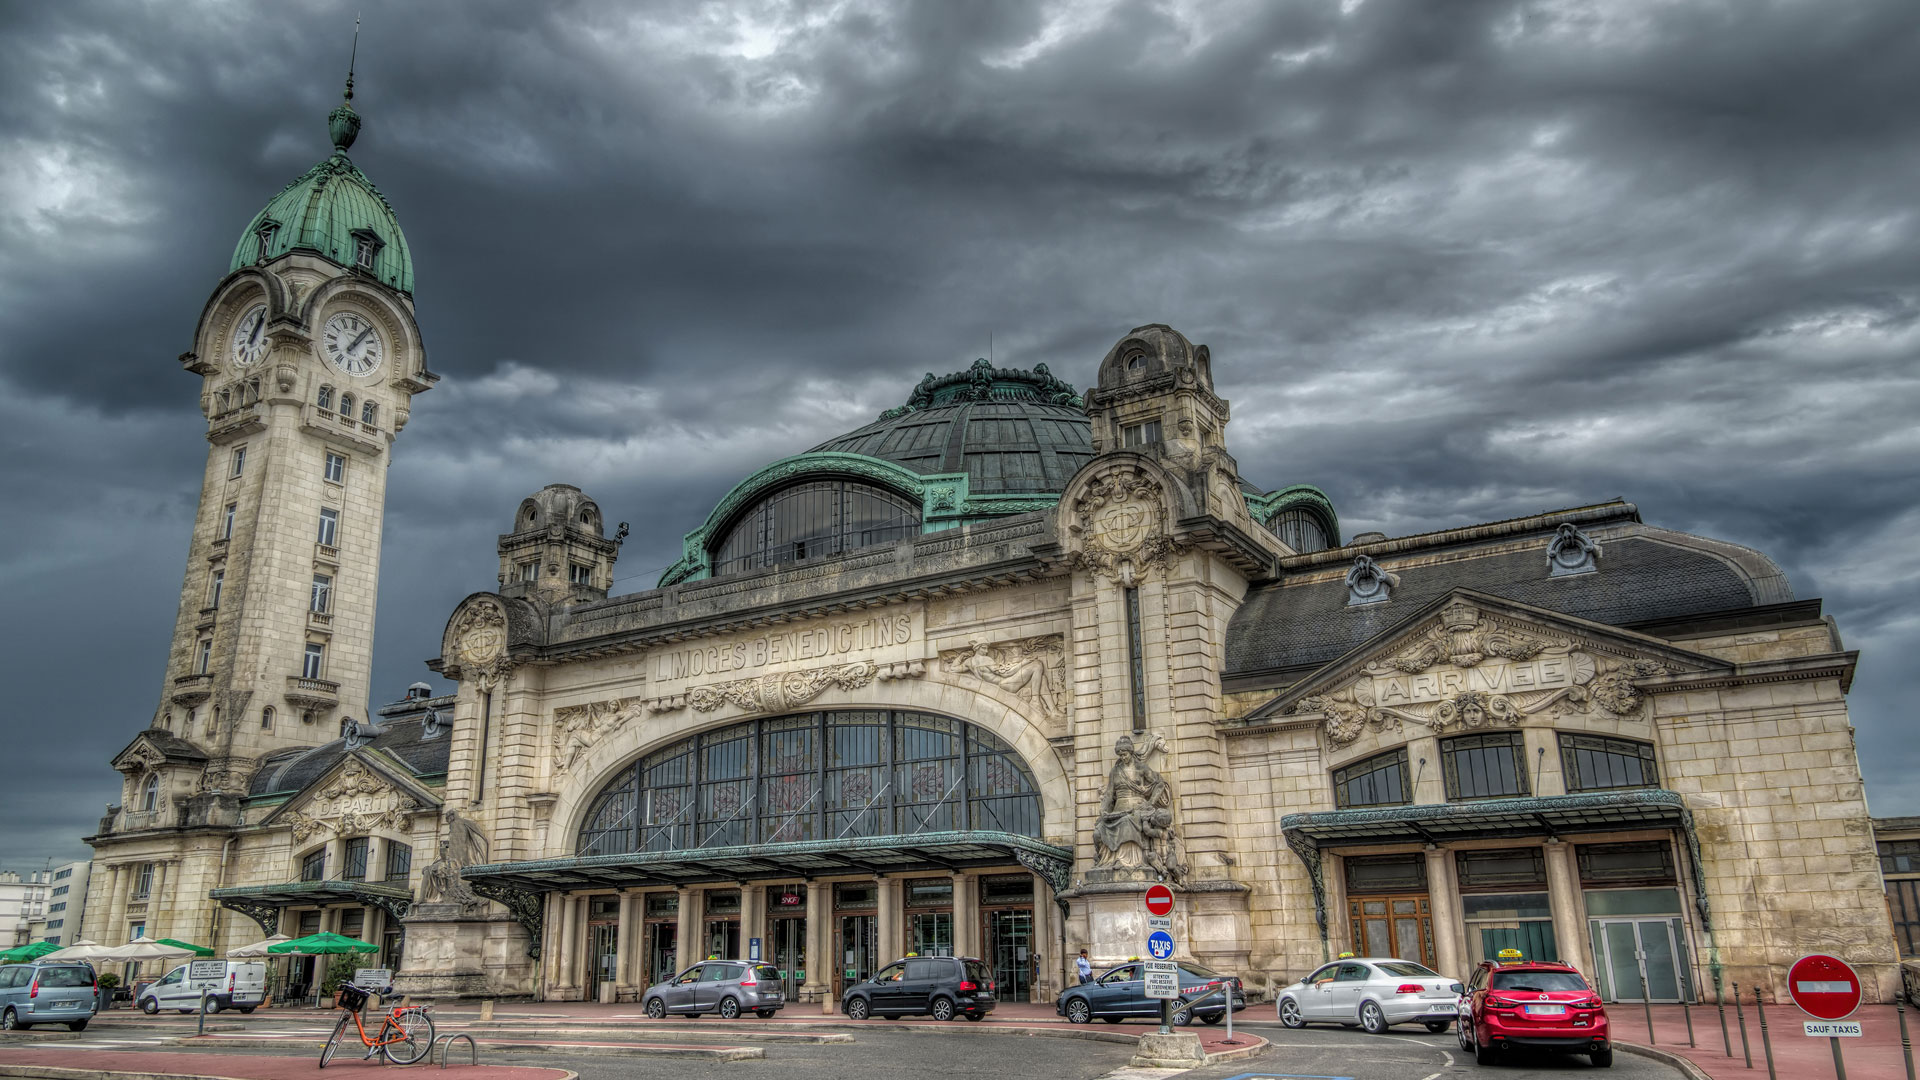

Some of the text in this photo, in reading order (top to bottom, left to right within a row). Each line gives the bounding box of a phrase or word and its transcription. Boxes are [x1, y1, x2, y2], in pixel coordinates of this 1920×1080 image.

[656, 614, 912, 683] LIMOGES BENEDICTINS
[1382, 658, 1566, 701] ARRIVEE
[320, 795, 388, 817] DEPART
[781, 896, 799, 904] SNCF
[1150, 939, 1171, 951] TAXIS
[1145, 962, 1154, 970] VOIE
[1806, 1025, 1860, 1034] SAUF TAXIS
